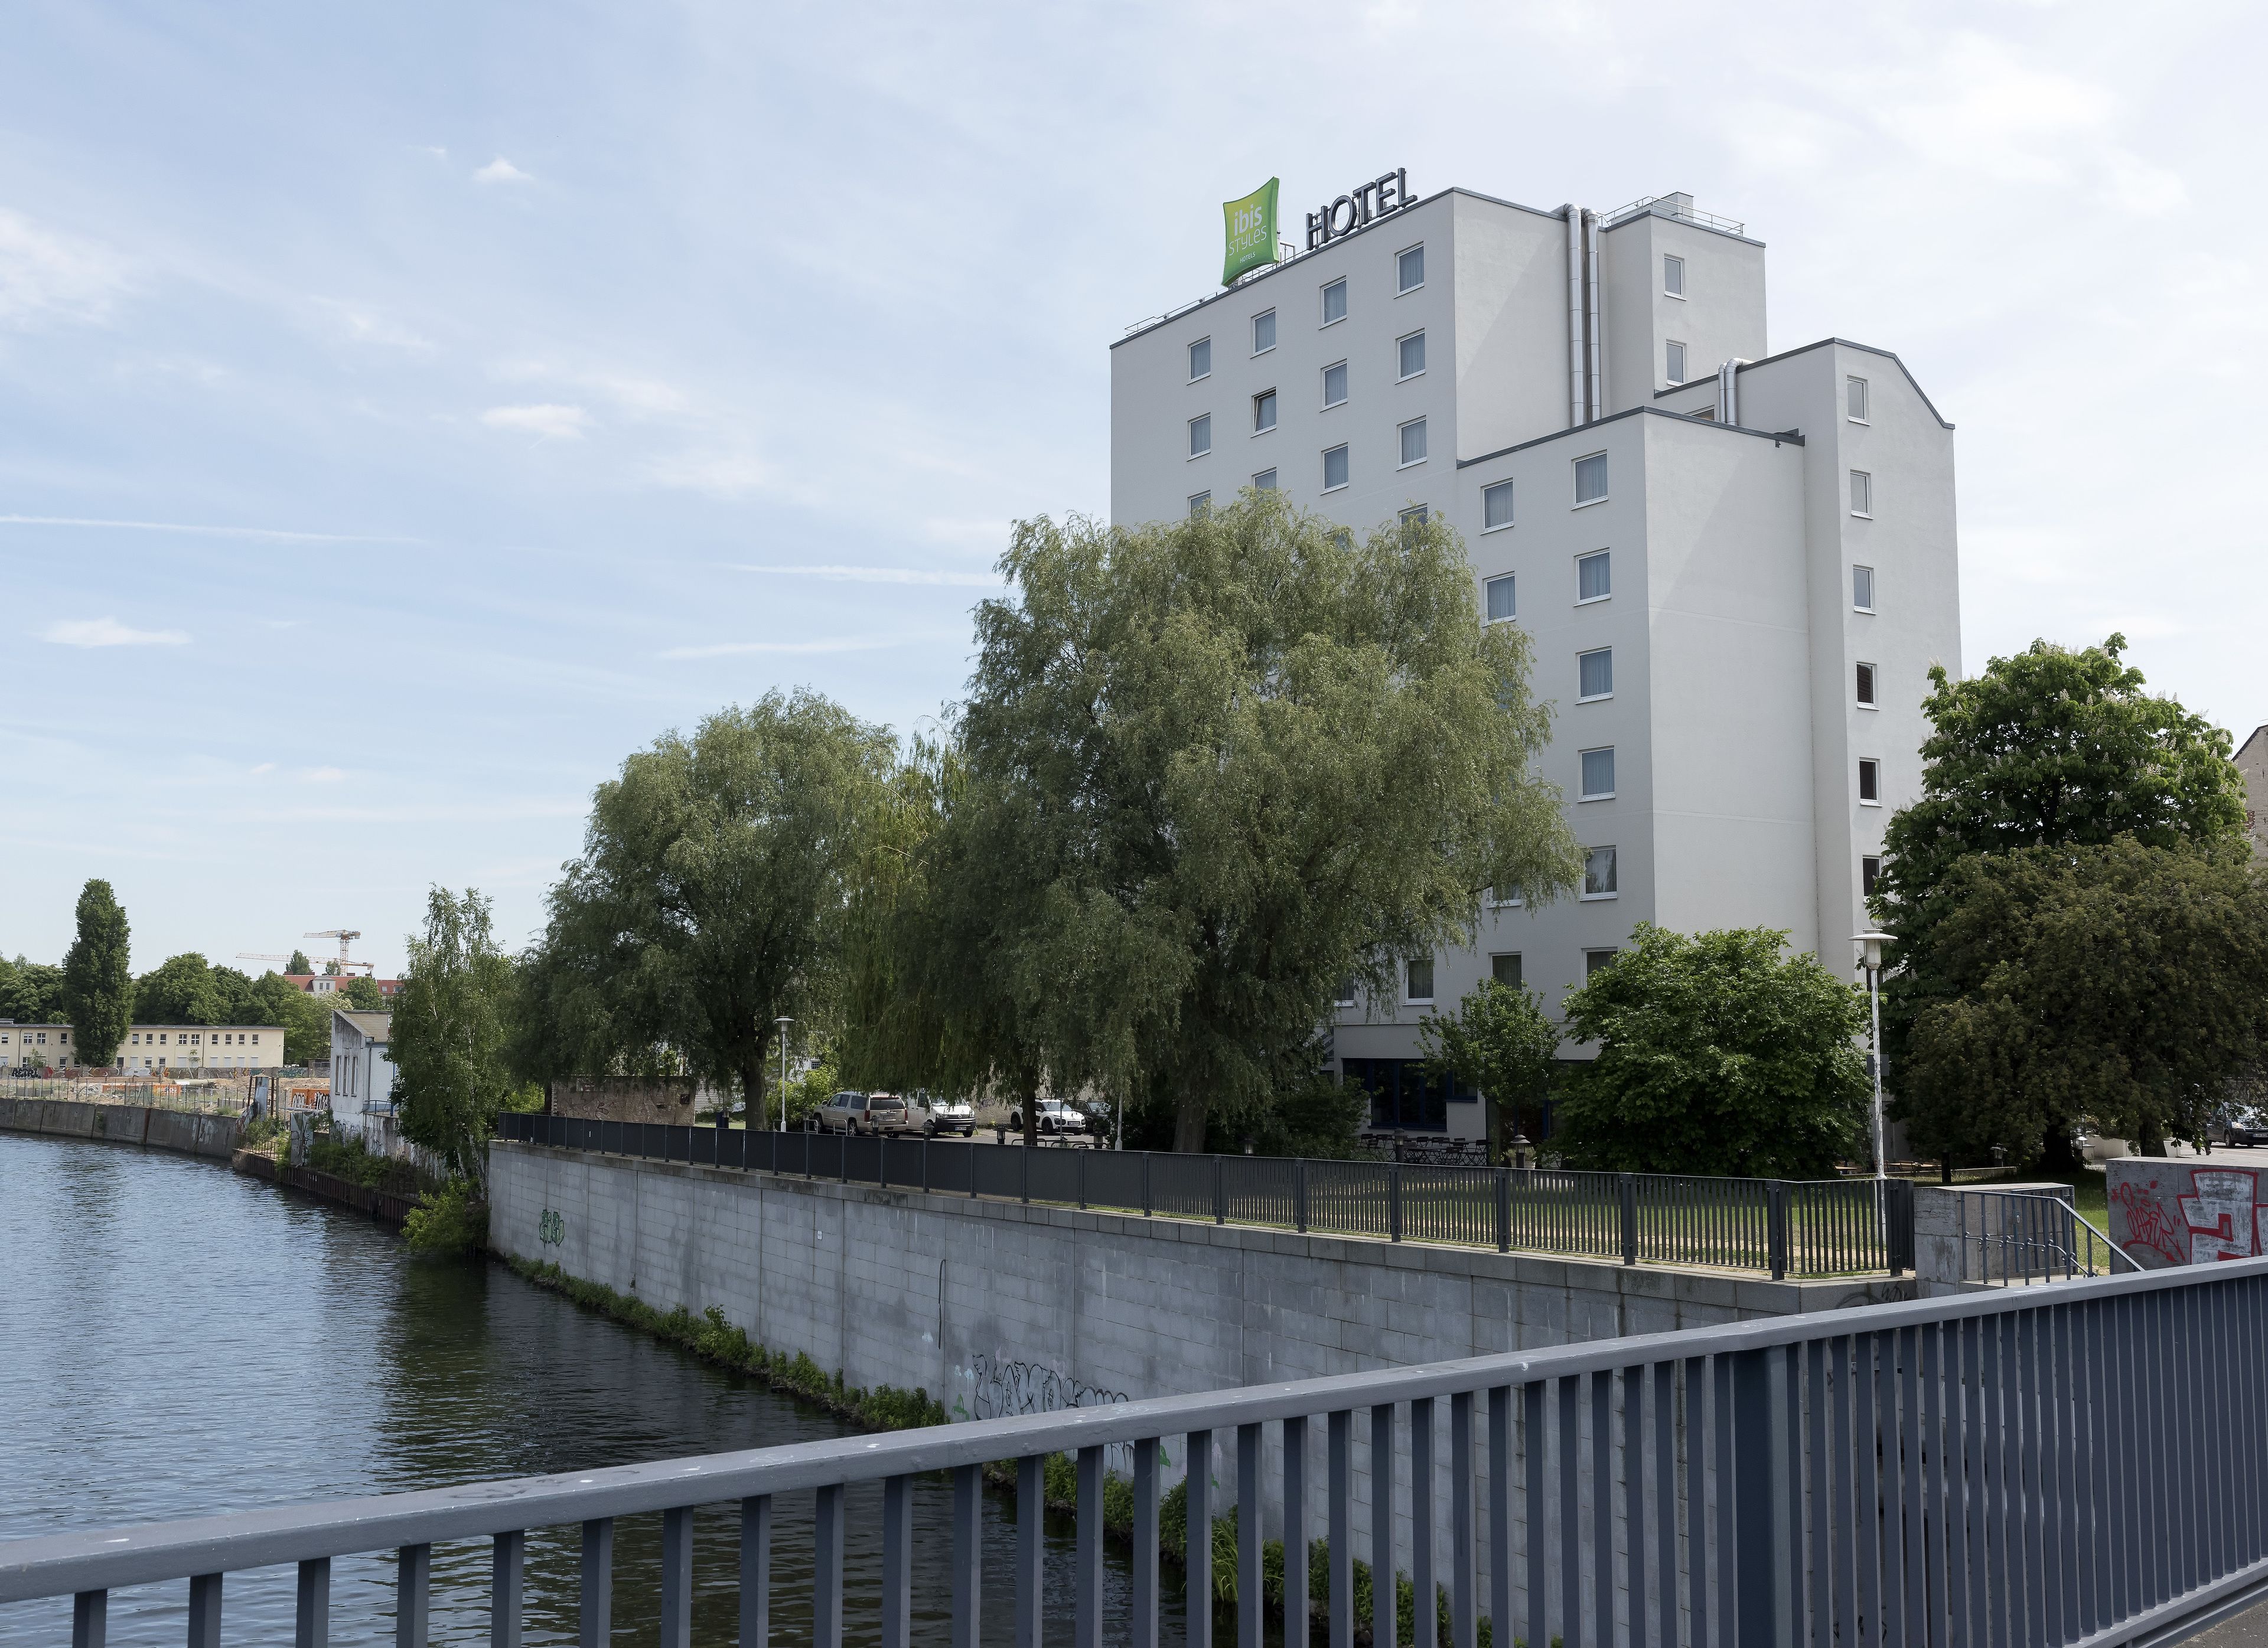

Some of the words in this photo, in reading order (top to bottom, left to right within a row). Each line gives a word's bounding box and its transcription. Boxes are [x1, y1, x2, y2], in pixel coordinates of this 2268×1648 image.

[1234, 204, 1262, 236] ibis
[1306, 168, 1418, 250] HOTEL
[1240, 252, 1256, 263] HOTELS
